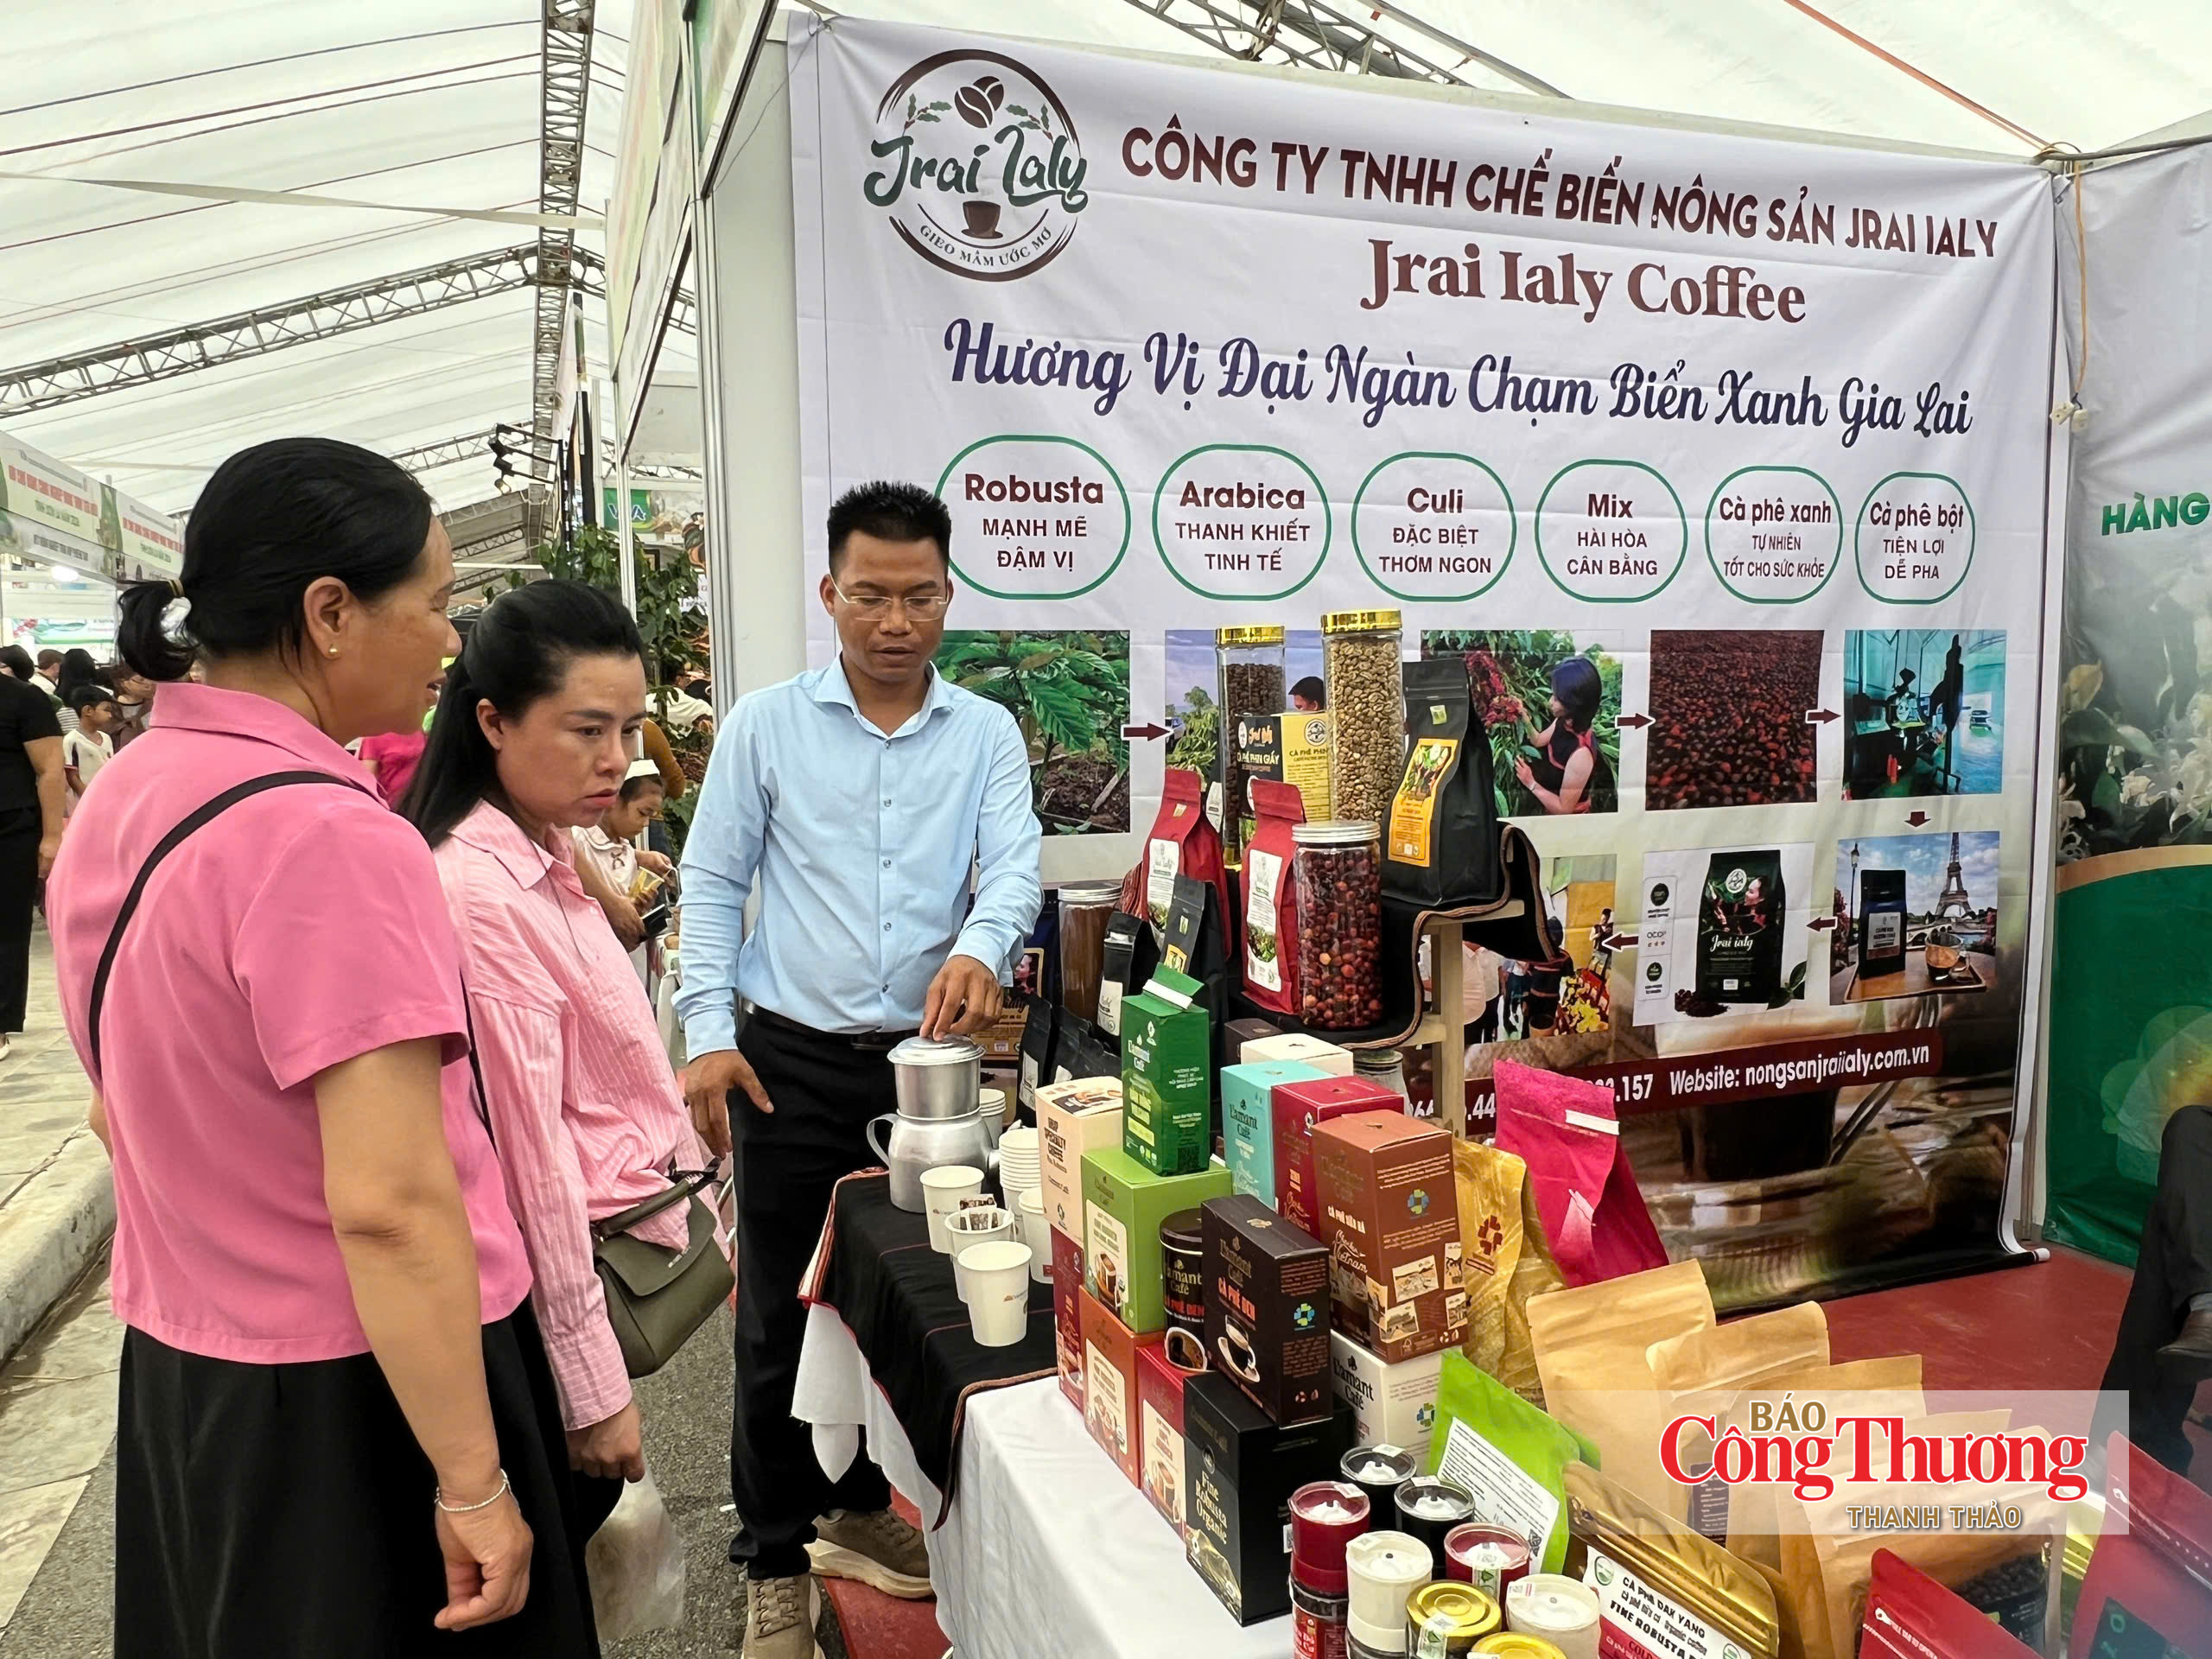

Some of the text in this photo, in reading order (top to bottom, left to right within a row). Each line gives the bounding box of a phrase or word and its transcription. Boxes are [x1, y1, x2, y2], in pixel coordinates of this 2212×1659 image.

[1122, 114, 1997, 257] CÔNG TY TNHH CHẾ BIẾN NÔNG SẢN JRAI IALY
[920, 225, 955, 255] GIEO
[1359, 238, 1806, 323] Jrai Ialy Coffee
[944, 318, 1972, 448] Hương Vị Đại Ngàn Chạm Biển Xanh Gia Lai
[965, 473, 1103, 504] Robusta
[1179, 480, 1306, 509] Arabica
[1407, 487, 1464, 514] Culi
[1587, 493, 1633, 518] Mix
[1719, 496, 1832, 526] Cà phê xanh
[1870, 501, 1964, 533] Cà phê bột
[2101, 492, 2211, 536] HÀNG
[982, 516, 1088, 540] MẠNH MẼ
[1175, 517, 1311, 542] THANH KHIẾT
[1392, 524, 1478, 548] ĐẶC BIỆT
[1577, 528, 1648, 549] HÀI HÒA
[1752, 532, 1802, 553] TỰ NHIÊN
[1883, 537, 1945, 556] TIỆN LỢI
[997, 546, 1074, 572] ĐẬM VỊ
[1205, 547, 1282, 571] TINH TẾ
[1379, 555, 1492, 574] THƠM NGON
[1567, 552, 1658, 576] CÂN BẰNG
[1724, 556, 1745, 576] TỐT
[1747, 562, 1771, 578] CHO
[1773, 559, 1795, 578] SỨC
[1885, 559, 1940, 580] DỄ PHA
[1669, 1066, 1740, 1096] Website:
[1745, 1045, 1929, 1092] nongsanjraiialy.com.vn
[1344, 1386, 1364, 1410] Café
[1201, 1471, 1219, 1502] Fine
[1195, 1479, 1228, 1529] Robusta
[1196, 1500, 1228, 1545] Organic
[1610, 1599, 1635, 1623] FINE
[1635, 1617, 1686, 1659] ROBUSTA
[1678, 1613, 1706, 1639] YANG
